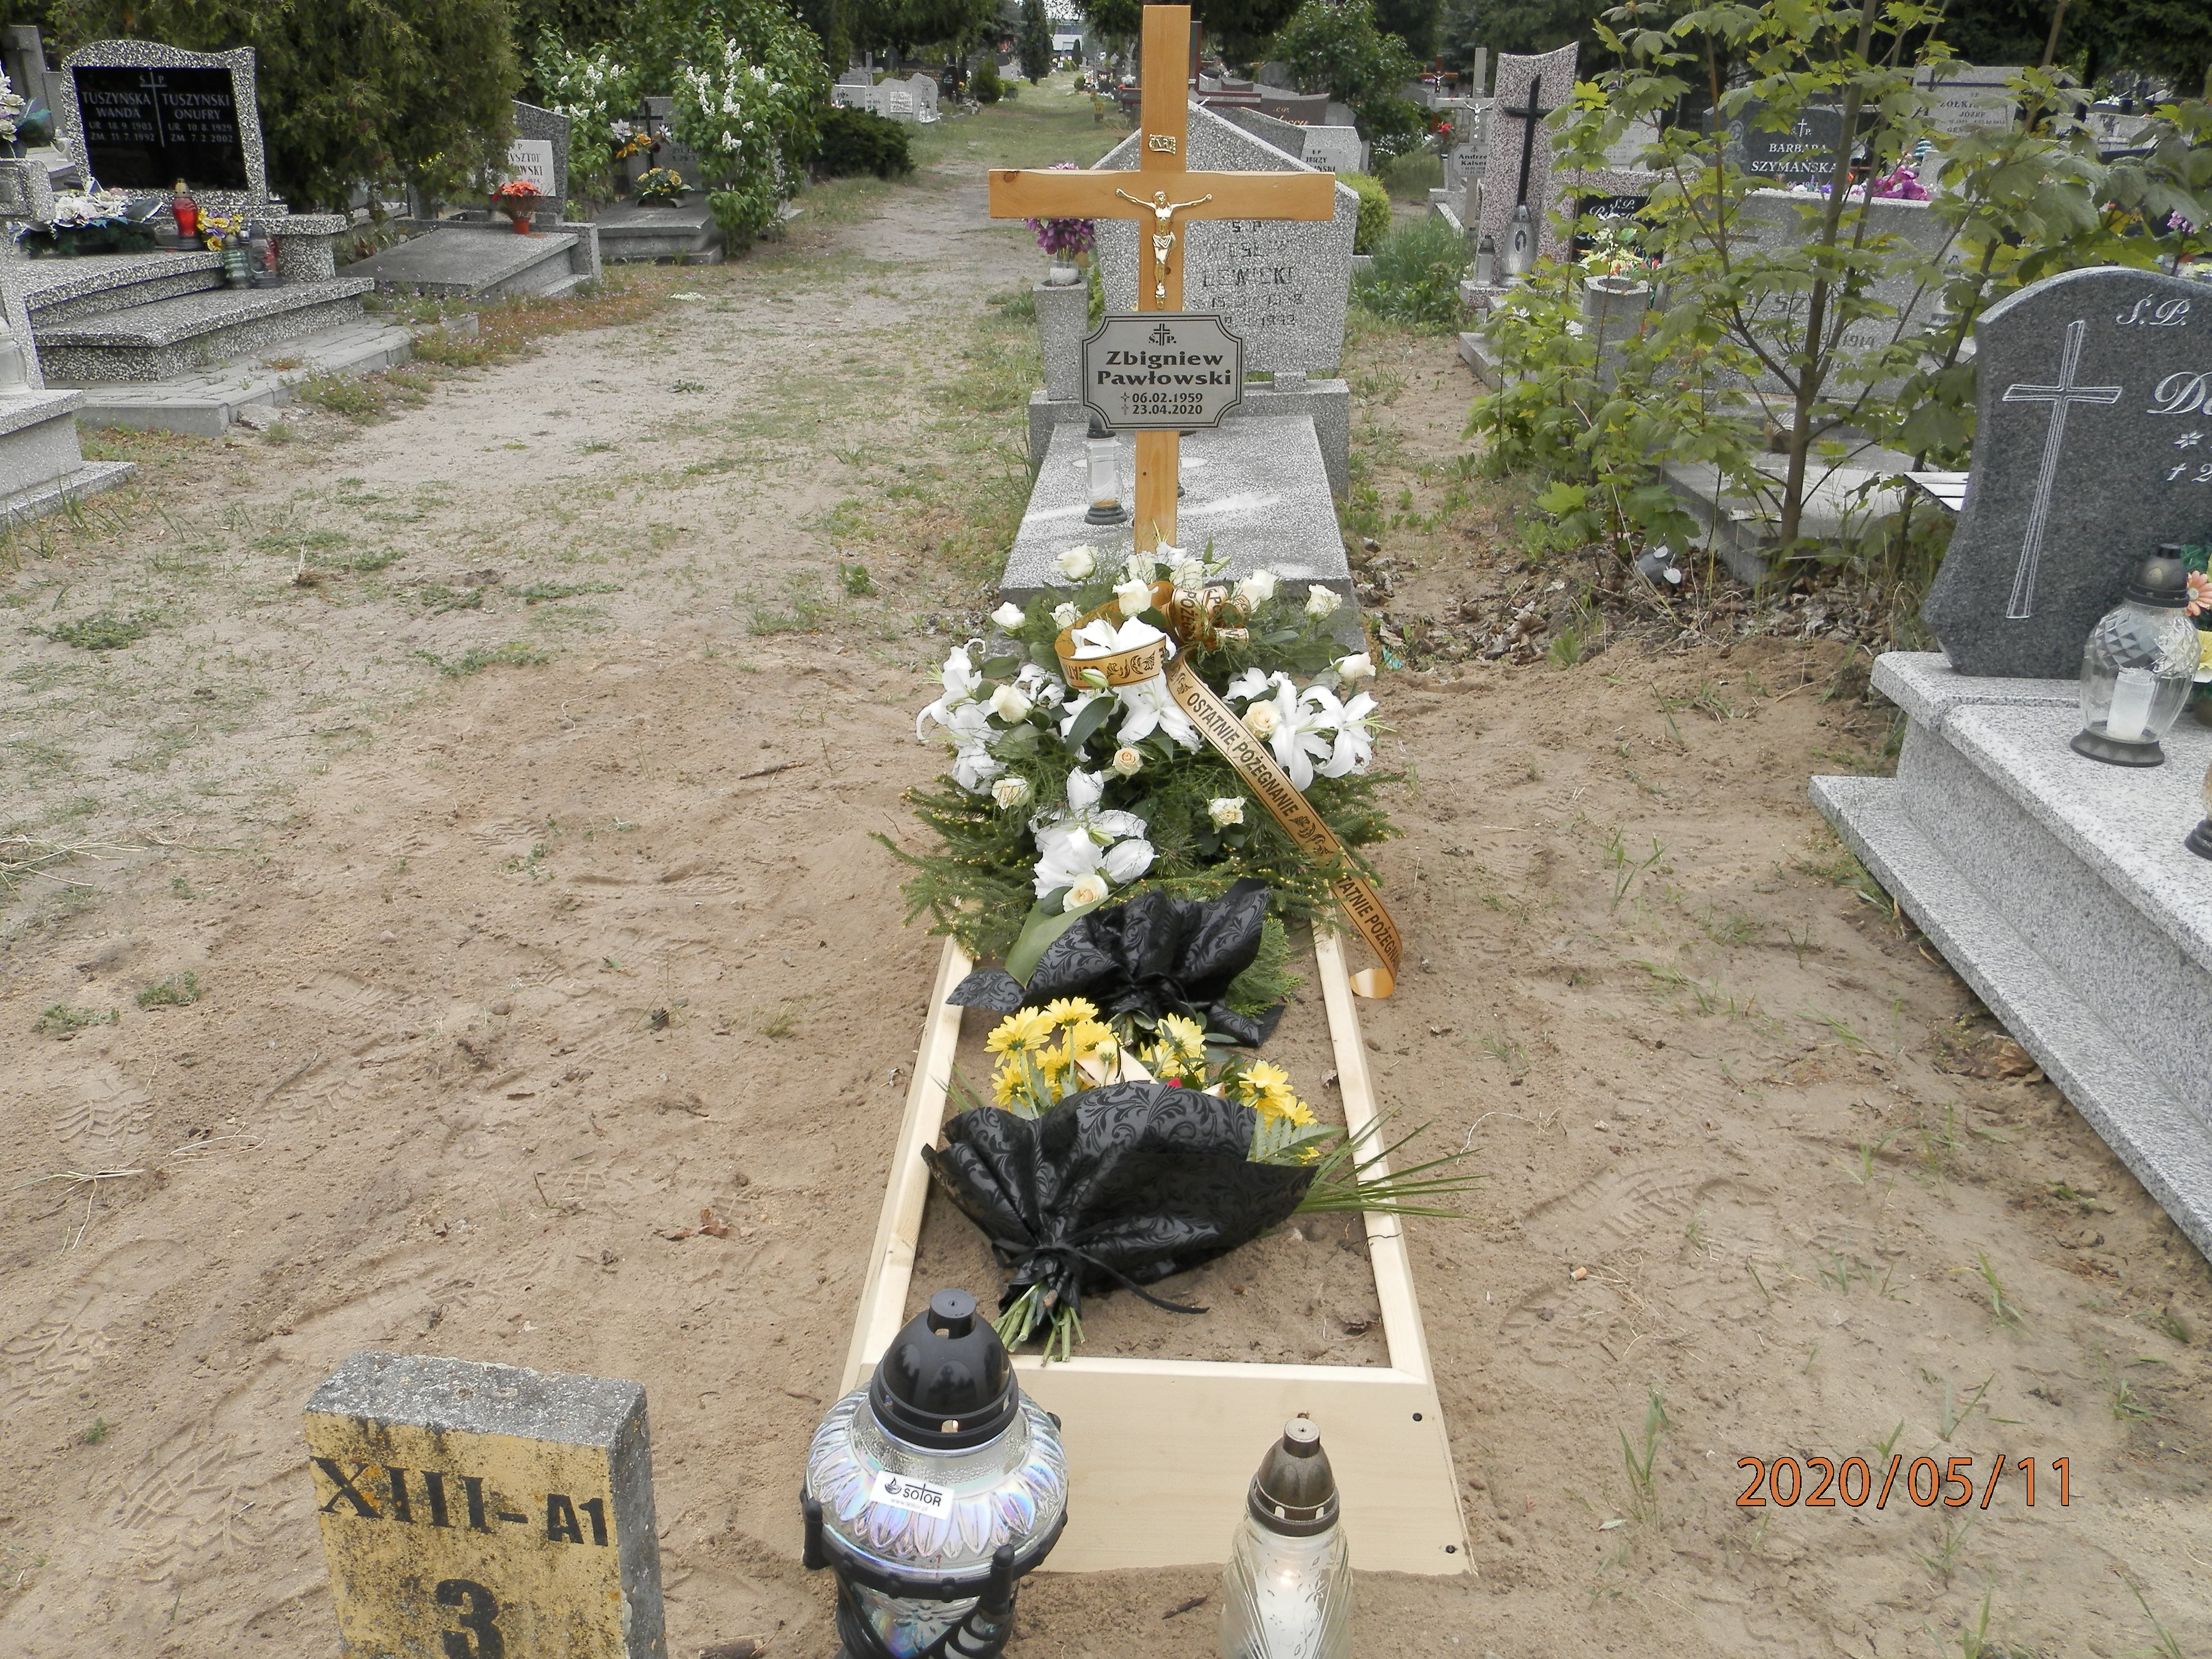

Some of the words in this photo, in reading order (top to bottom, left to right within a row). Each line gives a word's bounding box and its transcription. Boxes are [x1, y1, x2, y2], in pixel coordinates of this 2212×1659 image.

[96, 108, 141, 118] WANDA
[175, 109, 221, 120] ONUFRY
[1106, 351, 1223, 369] Zbigniew
[1097, 370, 1231, 385] Pawłowski
[1132, 392, 1203, 403] 06.02.1959
[1132, 405, 1203, 415] 23.04.2020
[1187, 692, 1240, 745] OSTATNIE
[1232, 741, 1299, 817] POŻEGNANIE
[436, 1578, 505, 1659] 3
